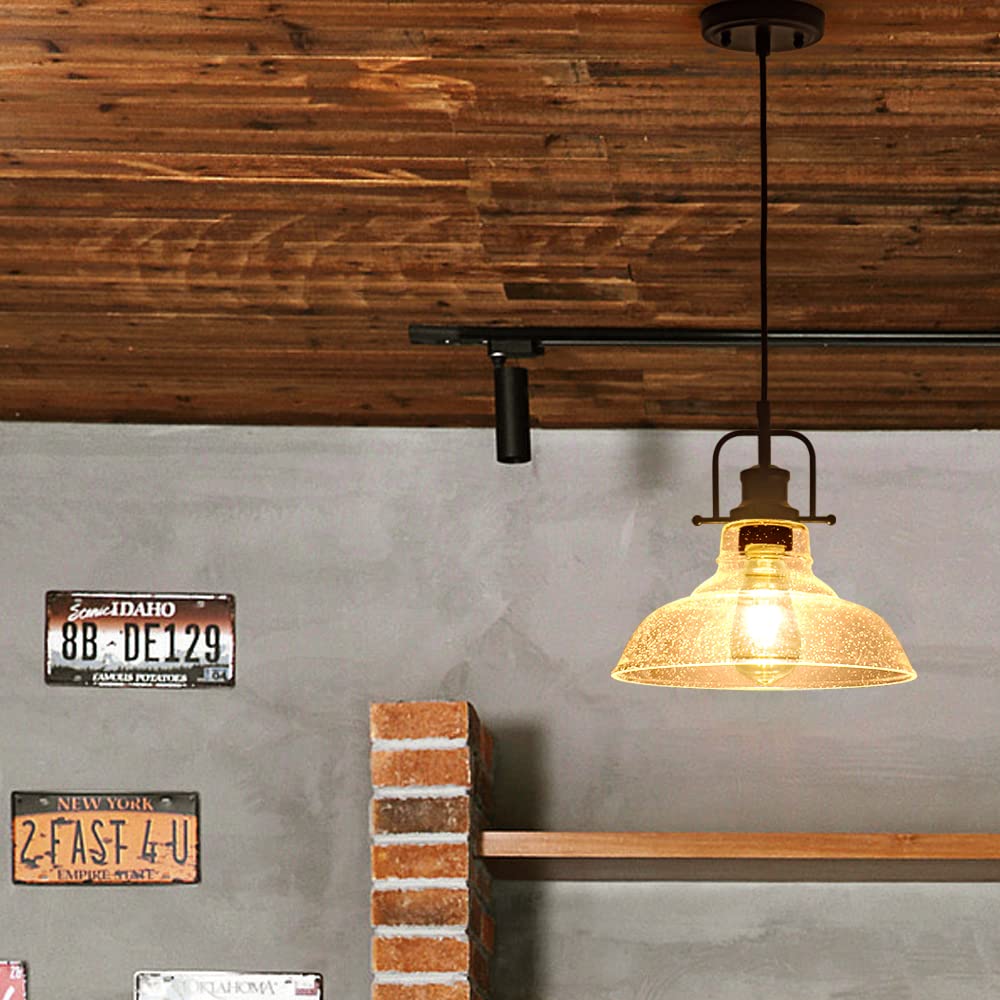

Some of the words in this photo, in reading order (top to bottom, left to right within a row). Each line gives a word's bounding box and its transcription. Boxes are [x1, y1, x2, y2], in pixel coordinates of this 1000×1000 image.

[110, 602, 176, 617] IDAHO
[62, 622, 98, 661] 8B
[124, 623, 221, 663] DE129
[92, 673, 134, 682] FAMOUS
[135, 673, 187, 682] POTATOES
[57, 797, 100, 811] NEW
[107, 797, 155, 811] YORK
[51, 819, 127, 865] FAST
[141, 819, 158, 864] 4
[172, 820, 188, 865] U
[57, 869, 110, 880] EMPIRE
[190, 979, 276, 997] OKLAHOMA
